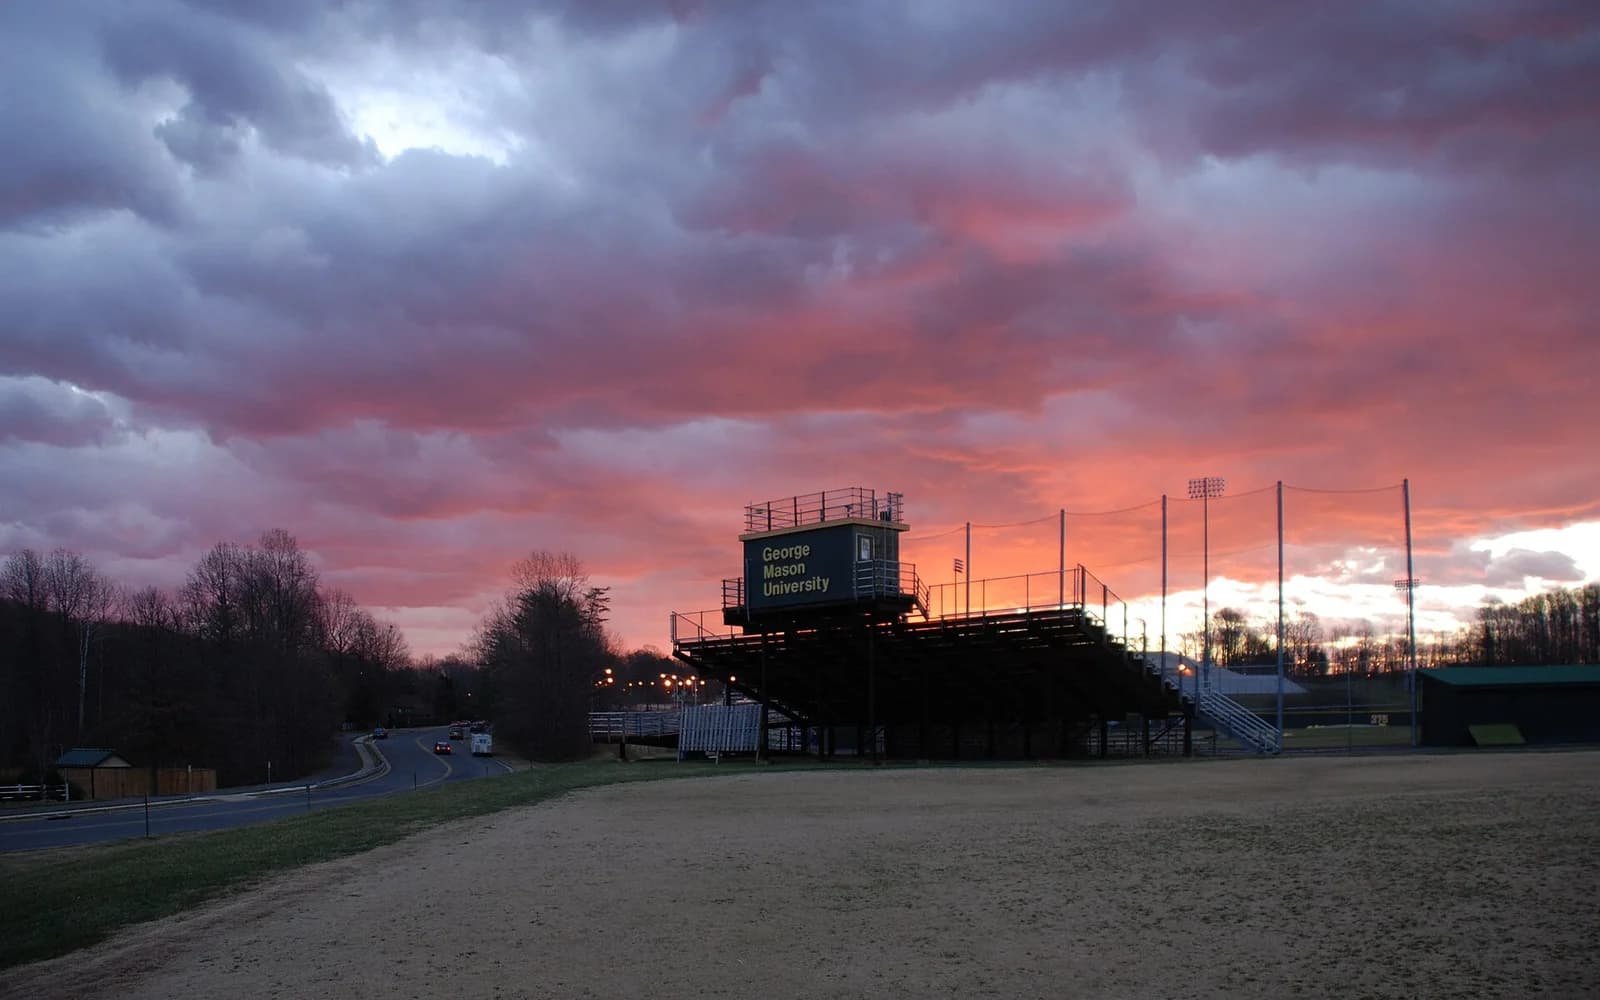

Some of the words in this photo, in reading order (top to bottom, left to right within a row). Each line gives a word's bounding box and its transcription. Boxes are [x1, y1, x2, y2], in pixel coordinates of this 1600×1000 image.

[762, 544, 811, 562] George
[763, 562, 806, 579] Mason
[763, 575, 830, 597] University
